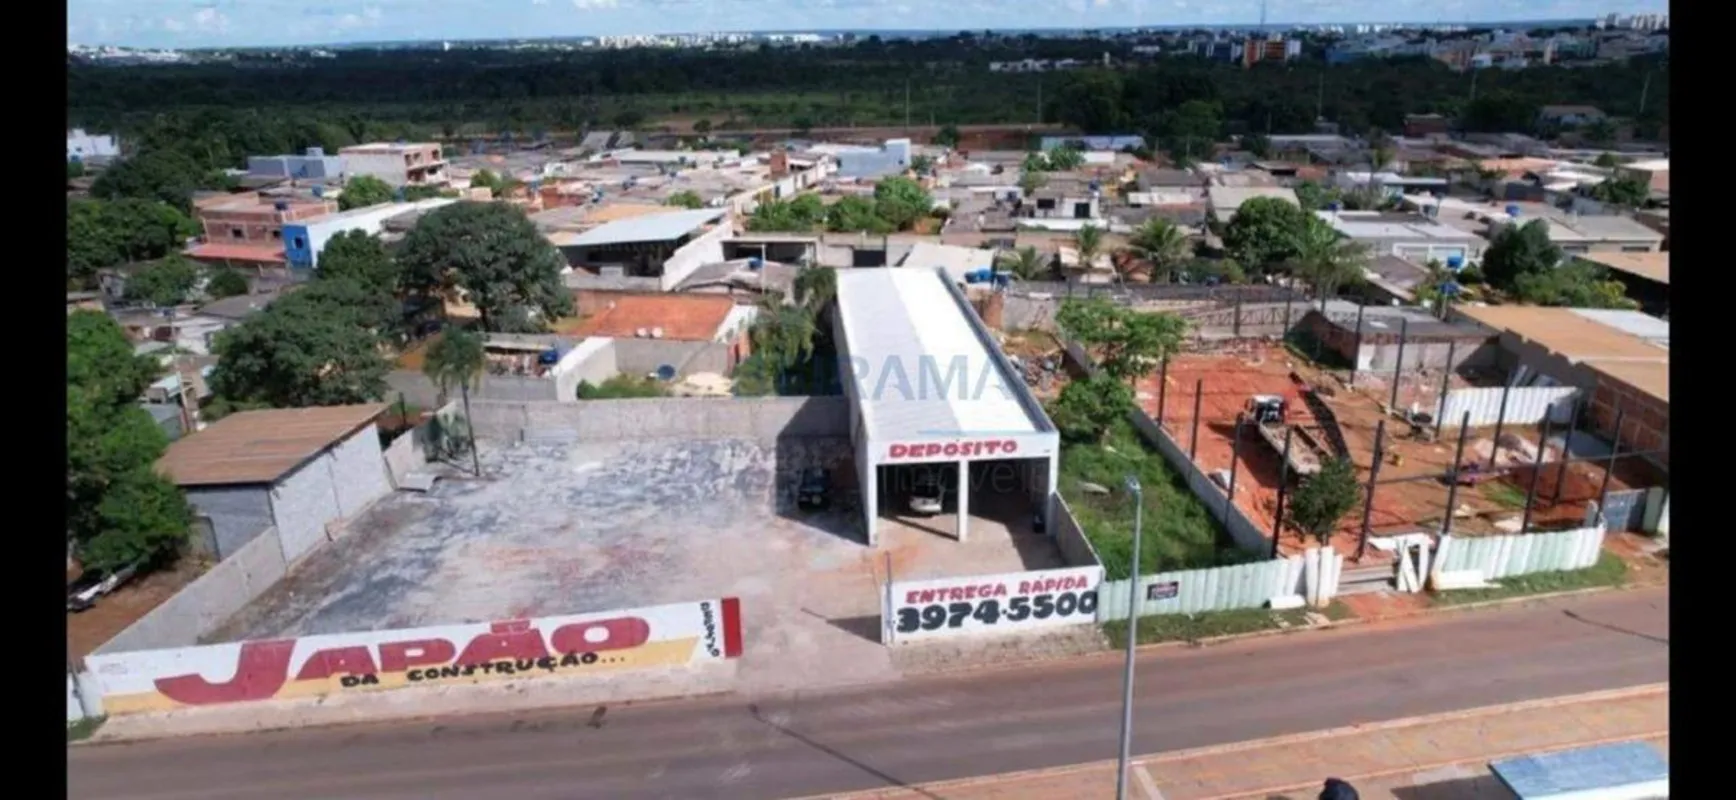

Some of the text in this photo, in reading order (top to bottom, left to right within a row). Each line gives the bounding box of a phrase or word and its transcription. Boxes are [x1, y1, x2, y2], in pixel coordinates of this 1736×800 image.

[906, 583, 1008, 604] ENTREGA
[153, 616, 651, 706] JAPÃO
[340, 673, 380, 688] DA
